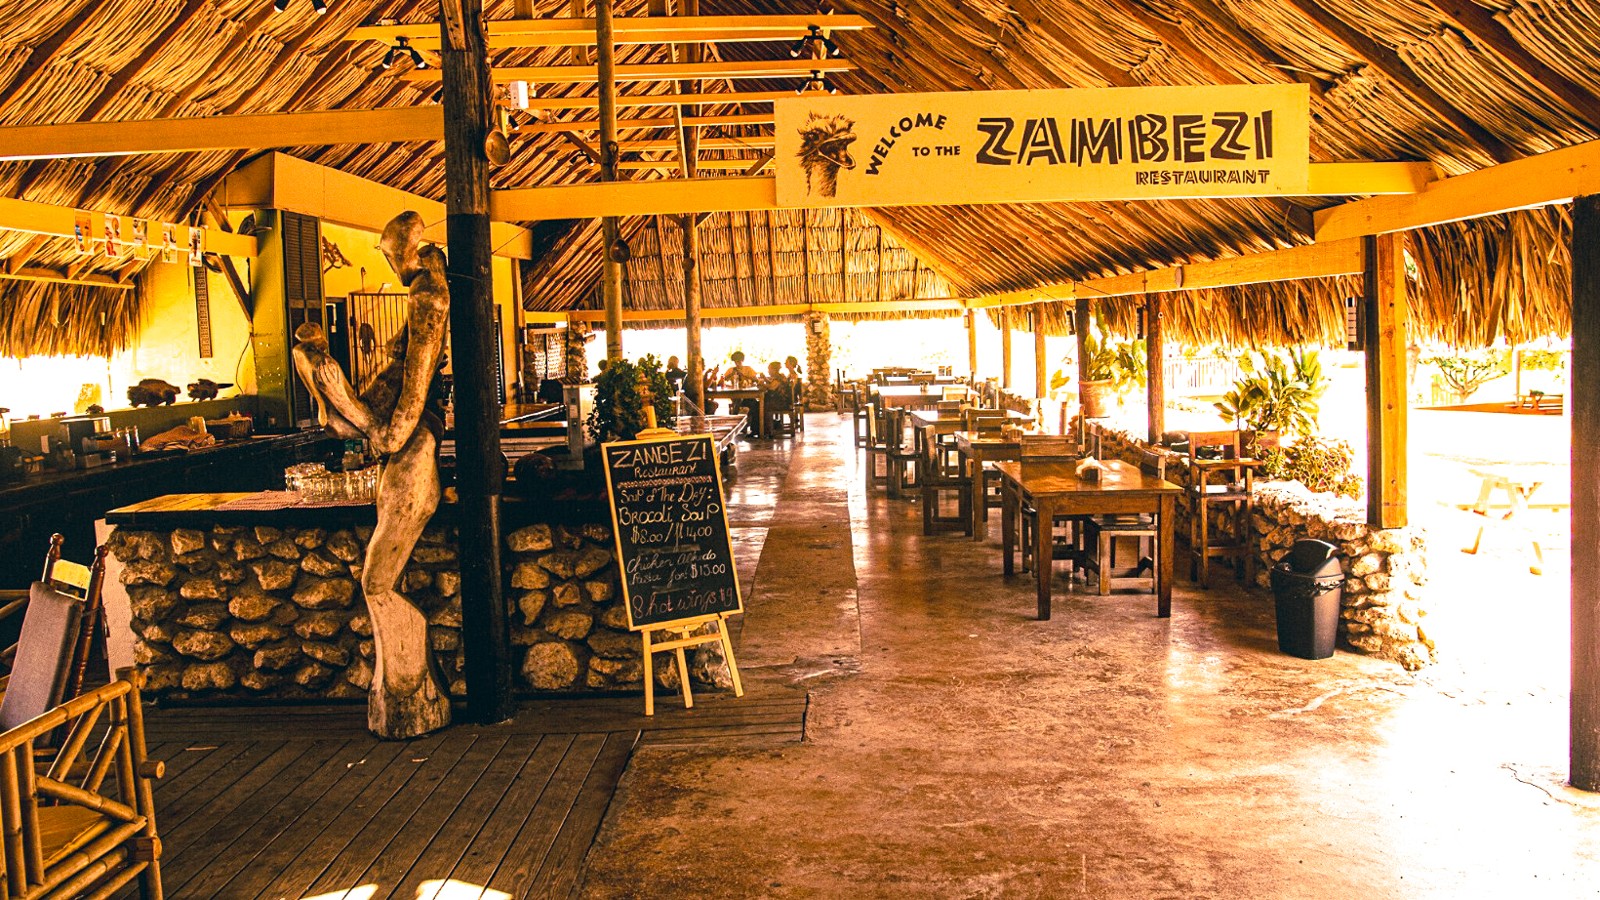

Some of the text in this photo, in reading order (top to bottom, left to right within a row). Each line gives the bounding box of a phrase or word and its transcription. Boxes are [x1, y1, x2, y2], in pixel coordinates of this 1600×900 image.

[865, 112, 947, 176] WELCOME
[912, 145, 961, 157] TO THE
[976, 109, 1273, 167] ZAMBEZI
[1136, 169, 1271, 185] RESTAURANT
